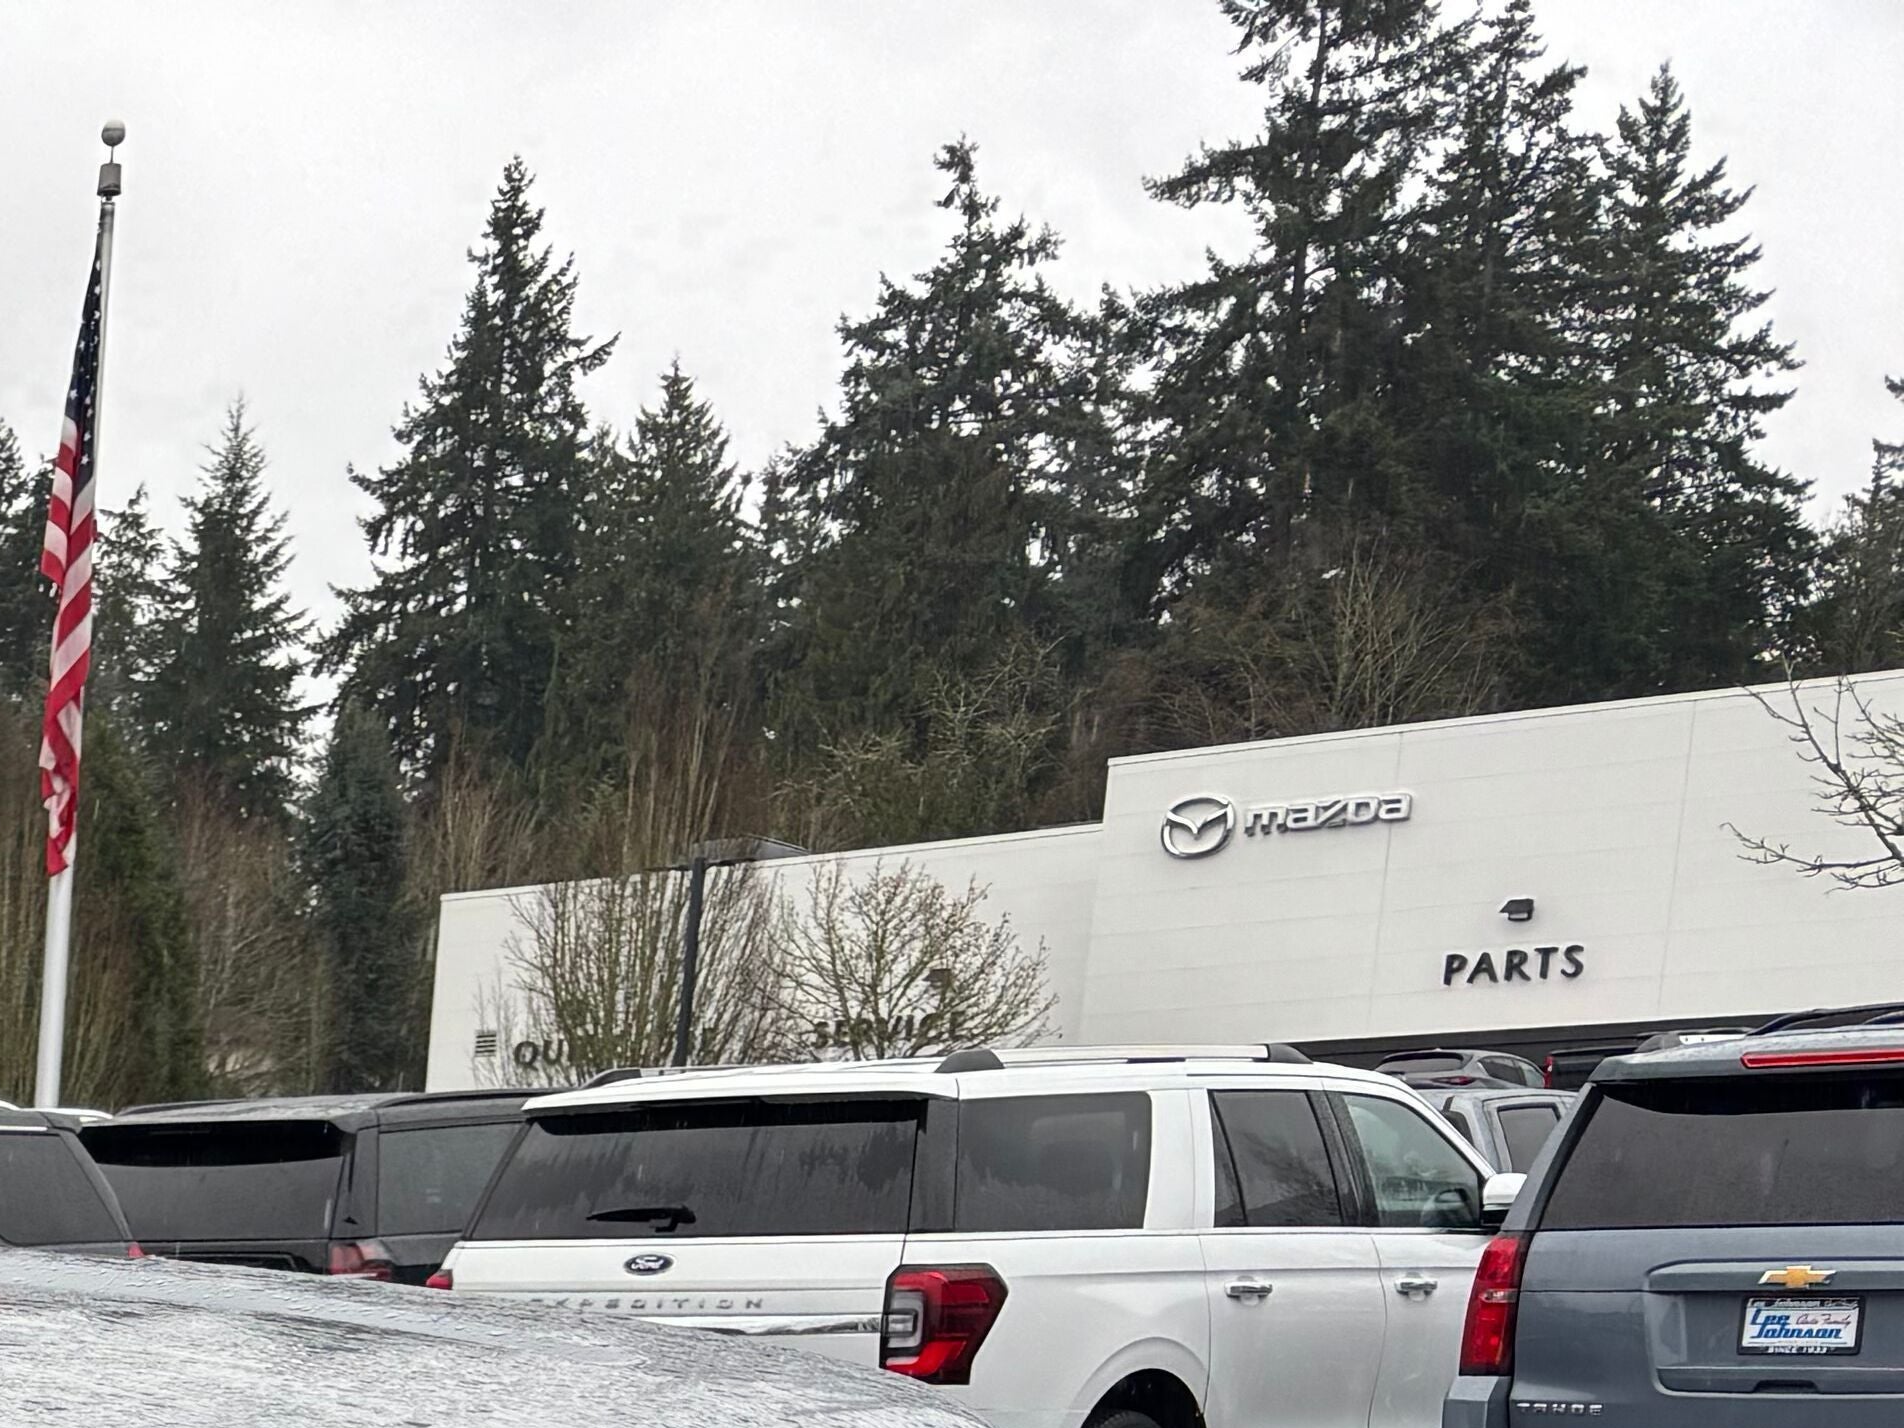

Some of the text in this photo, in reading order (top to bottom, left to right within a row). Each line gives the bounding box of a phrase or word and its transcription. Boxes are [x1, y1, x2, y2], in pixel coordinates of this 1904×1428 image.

[1243, 791, 1414, 837] mazda
[1442, 944, 1585, 987] PARTS
[1749, 1308, 1791, 1326] Lee
[1749, 1322, 1844, 1340] Johnson
[1516, 1402, 1603, 1416] TAHOE
